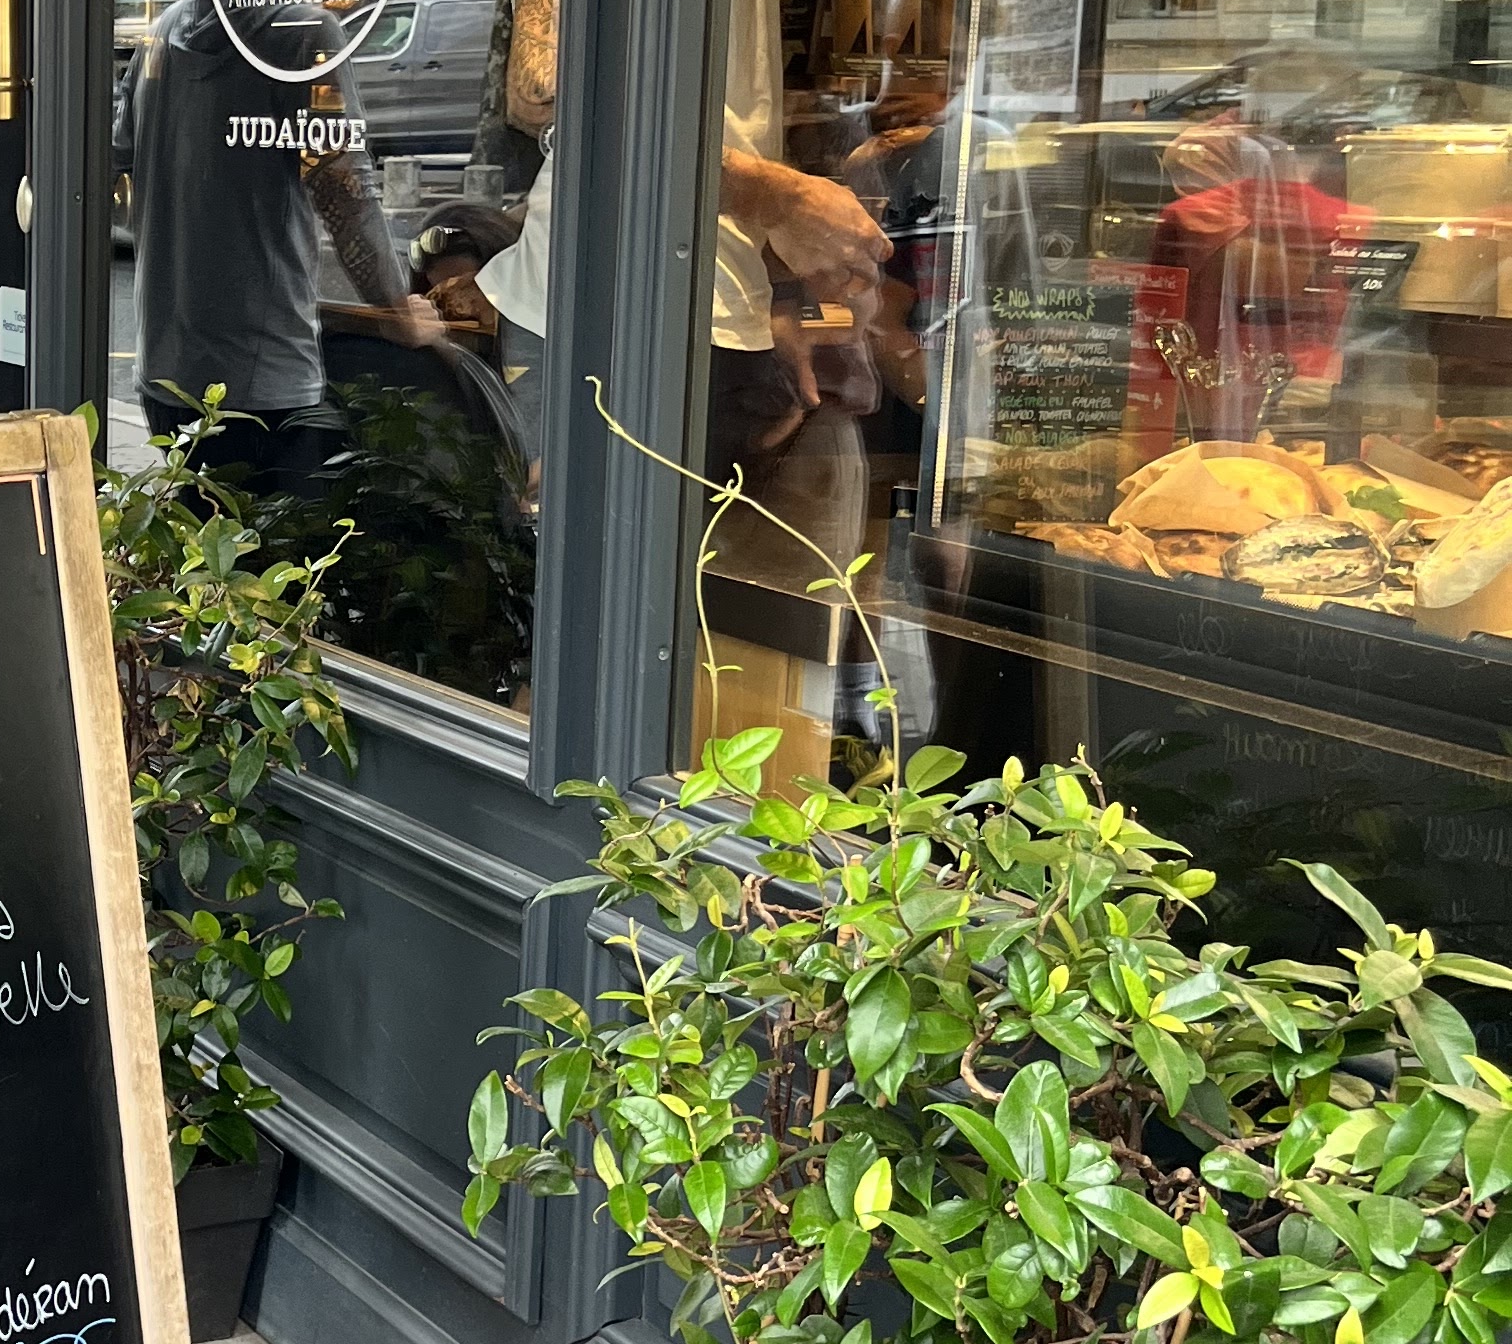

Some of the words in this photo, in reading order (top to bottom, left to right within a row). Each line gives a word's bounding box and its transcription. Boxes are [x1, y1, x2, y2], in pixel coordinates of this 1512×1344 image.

[226, 109, 366, 155] JUDAÏQUE
[1009, 289, 1029, 307] NOS
[1037, 288, 1083, 307] WRAPS
